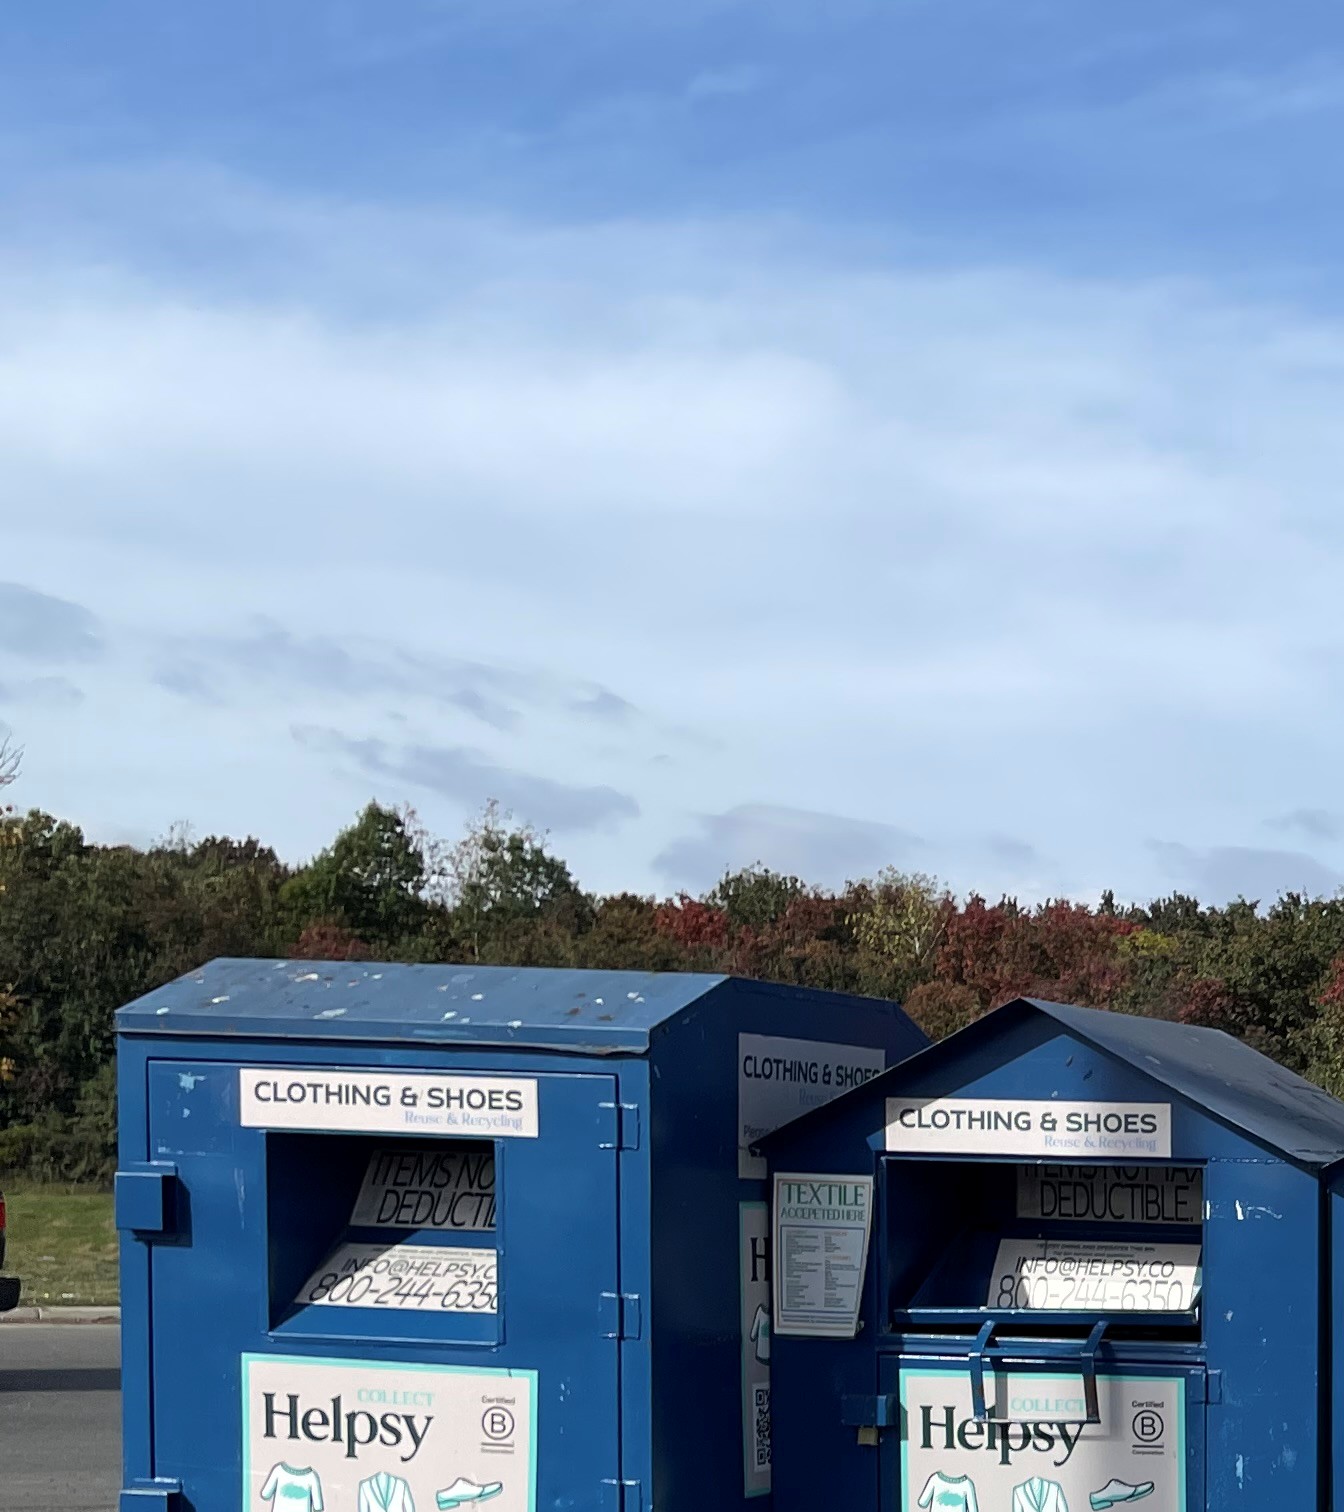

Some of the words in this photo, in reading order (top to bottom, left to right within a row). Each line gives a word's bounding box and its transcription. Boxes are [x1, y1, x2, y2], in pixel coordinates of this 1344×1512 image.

[743, 1055, 818, 1084] CLOTHING
[822, 1063, 832, 1086] &
[254, 1081, 391, 1106] CLOTHING
[400, 1087, 418, 1106] &
[427, 1088, 523, 1111] SHOES
[404, 1111, 443, 1125] Reuse
[447, 1114, 459, 1125] &
[462, 1113, 523, 1131] Recycling
[900, 1108, 1031, 1131] CLOTHING
[1040, 1112, 1058, 1132] &
[1066, 1113, 1157, 1134] SHOES
[1044, 1135, 1081, 1147] Reuse
[1084, 1135, 1098, 1147] &
[1099, 1136, 1157, 1152] Recycling
[372, 1153, 453, 1188] ITEMS
[780, 1183, 866, 1206] TEXTILE
[1040, 1182, 1194, 1223] DEDUCTIBLE.
[1014, 1257, 1175, 1278] INFO@HELPSY.CO
[997, 1275, 1183, 1310] 800-244-6350
[357, 1388, 436, 1407] COLLECT
[1010, 1397, 1086, 1413] COLLECT
[1132, 1400, 1165, 1408] Certified
[262, 1392, 434, 1461] Helpsy
[490, 1413, 507, 1433] B
[1141, 1417, 1156, 1436] B
[919, 1405, 1086, 1467] Helpsy
